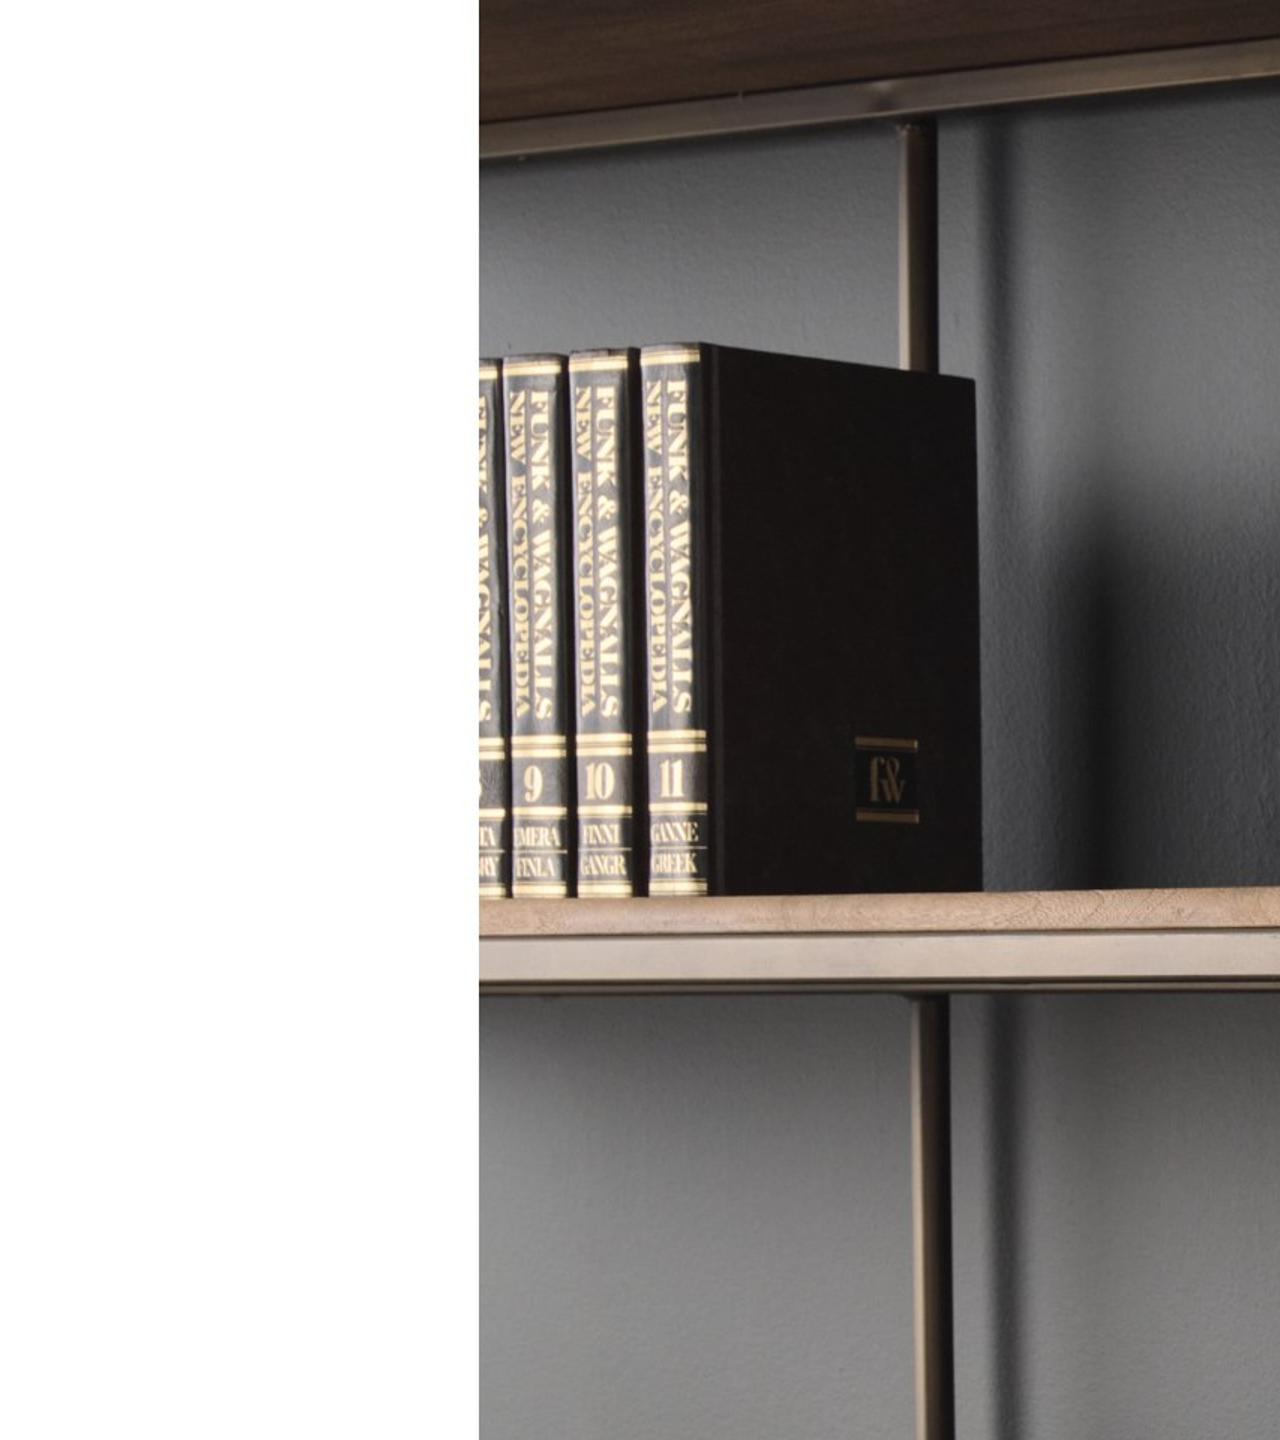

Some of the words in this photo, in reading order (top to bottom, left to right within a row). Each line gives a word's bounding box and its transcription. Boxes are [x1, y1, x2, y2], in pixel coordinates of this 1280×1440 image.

[510, 390, 527, 465] NEW
[531, 391, 549, 491] FUNK
[576, 386, 592, 460] NEW
[596, 386, 616, 487] FUNK
[647, 380, 663, 455] NEW
[667, 380, 688, 481] FUNK
[532, 498, 550, 524] &
[598, 495, 617, 520] &
[669, 490, 689, 515] &
[511, 476, 530, 717] ENCYCLOPEDIA
[532, 529, 552, 720] WAGNALLS
[577, 473, 596, 716] ENCYCLOPEDIA
[598, 526, 619, 717] WAGNALLS
[648, 467, 668, 712] ENCYCLOPEDIA
[670, 520, 692, 713] WAGNALLS
[523, 765, 544, 802] 9
[586, 762, 615, 799] 10
[659, 759, 685, 798] 11
